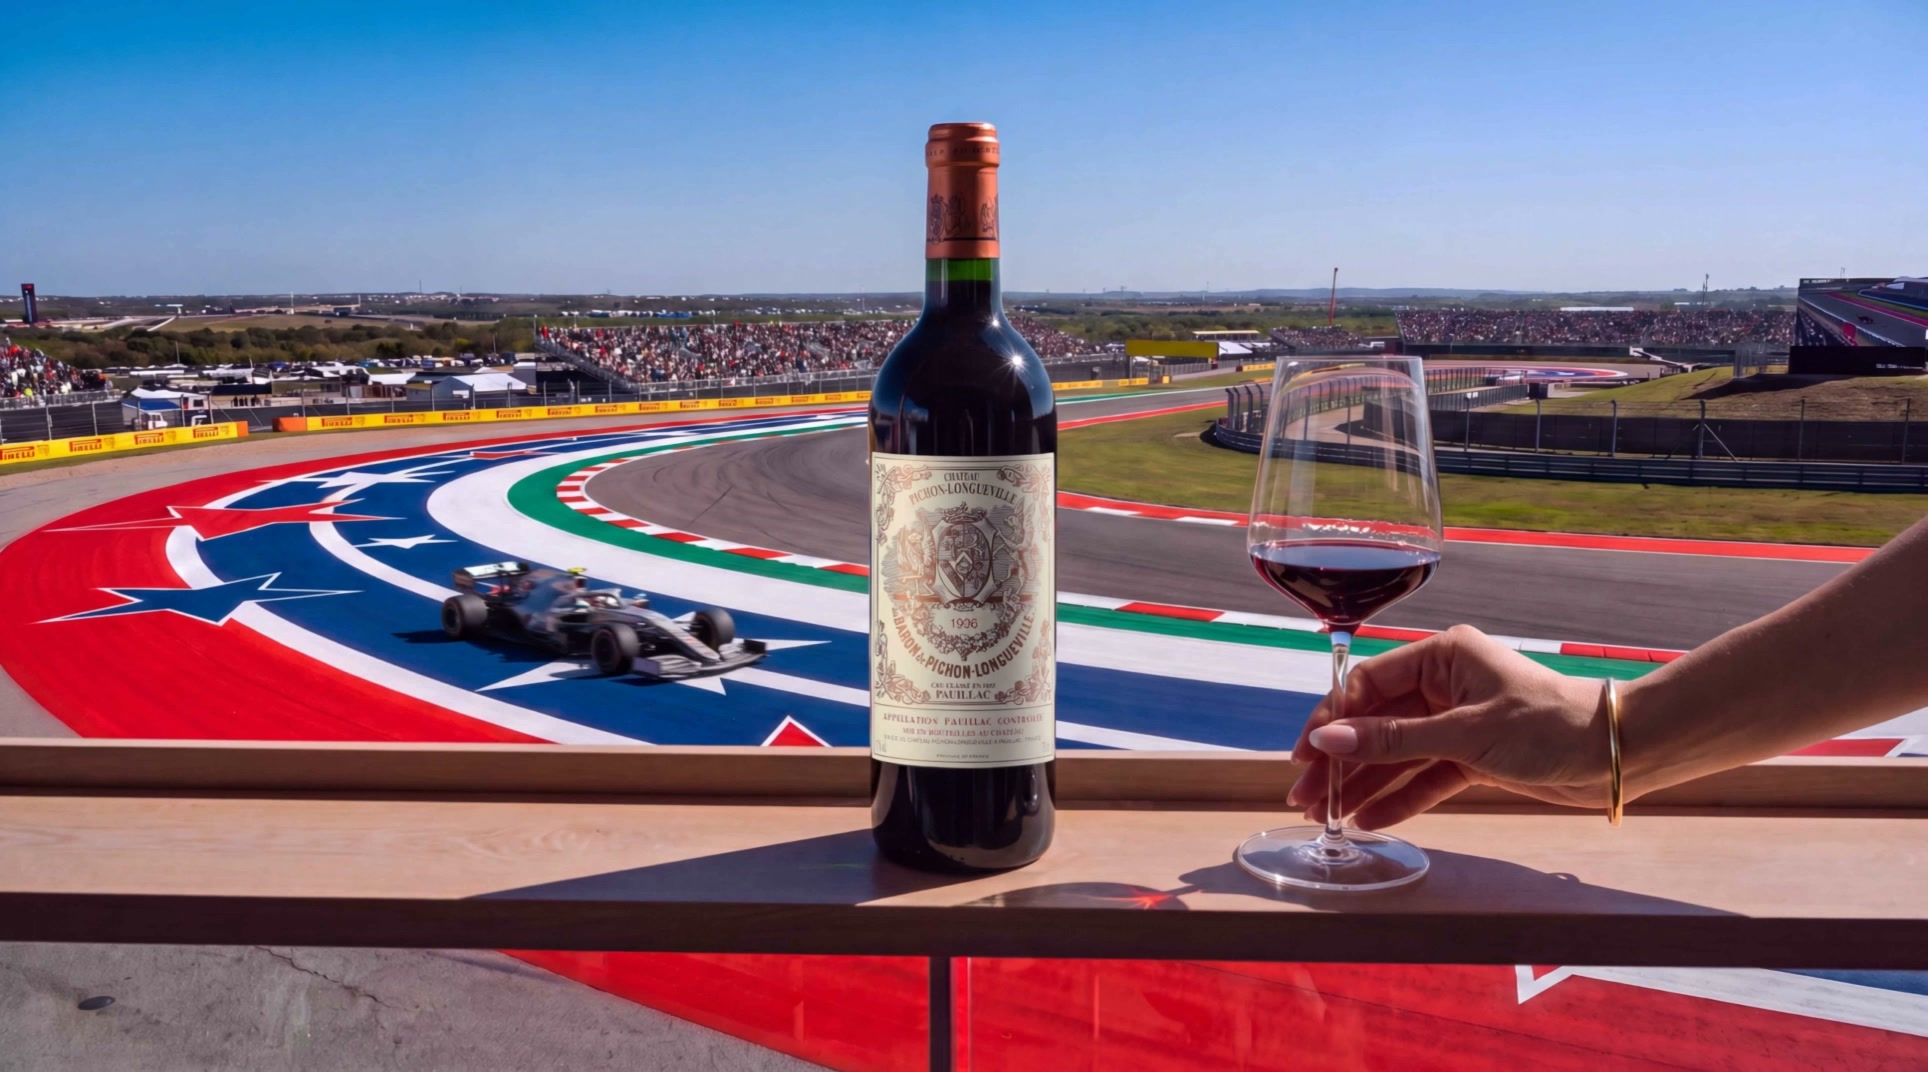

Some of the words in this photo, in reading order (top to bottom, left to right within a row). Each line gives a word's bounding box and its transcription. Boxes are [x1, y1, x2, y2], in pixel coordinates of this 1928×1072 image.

[134, 432, 164, 445] PIRELLI
[193, 426, 219, 438] PIRELLI
[69, 438, 102, 452] PIRELLI
[908, 482, 1017, 505] PICHON-LONGUEVILLE
[894, 615, 921, 657] BARON
[925, 614, 1034, 680] PICHON-LONGUEVILLE
[936, 690, 991, 699] PAUILLAC
